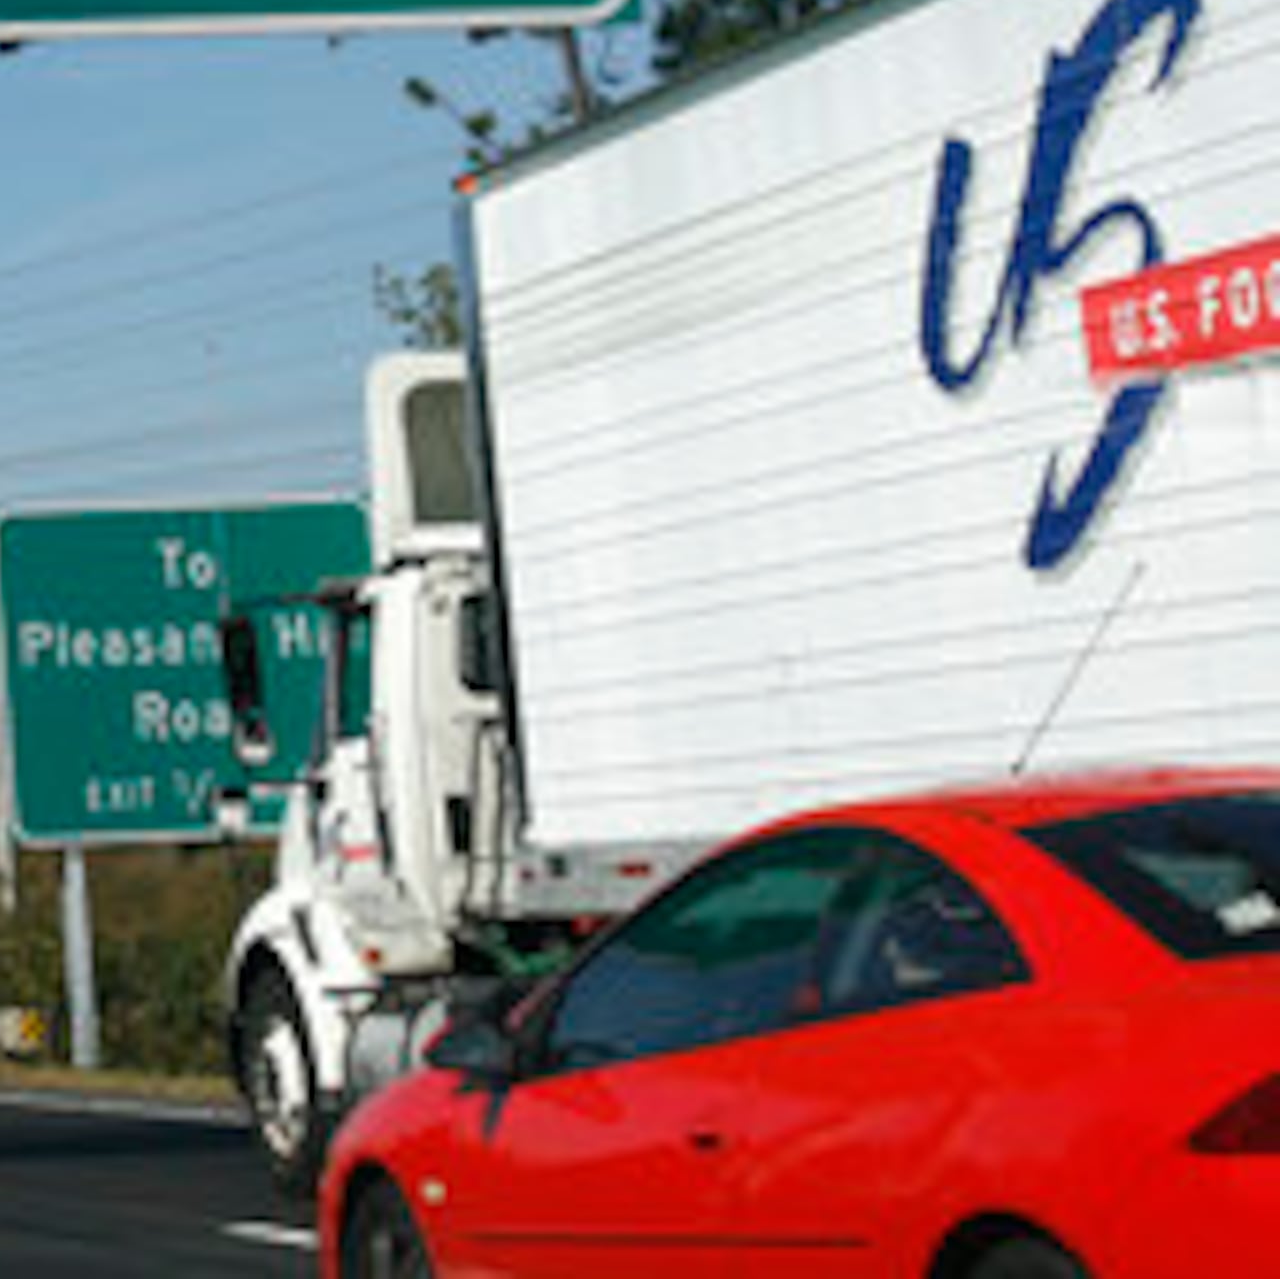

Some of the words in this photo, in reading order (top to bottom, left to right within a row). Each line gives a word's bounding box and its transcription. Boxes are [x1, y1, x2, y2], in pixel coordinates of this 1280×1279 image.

[156, 537, 218, 589] To
[18, 622, 223, 666] Pleasan
[132, 690, 233, 742] Roa
